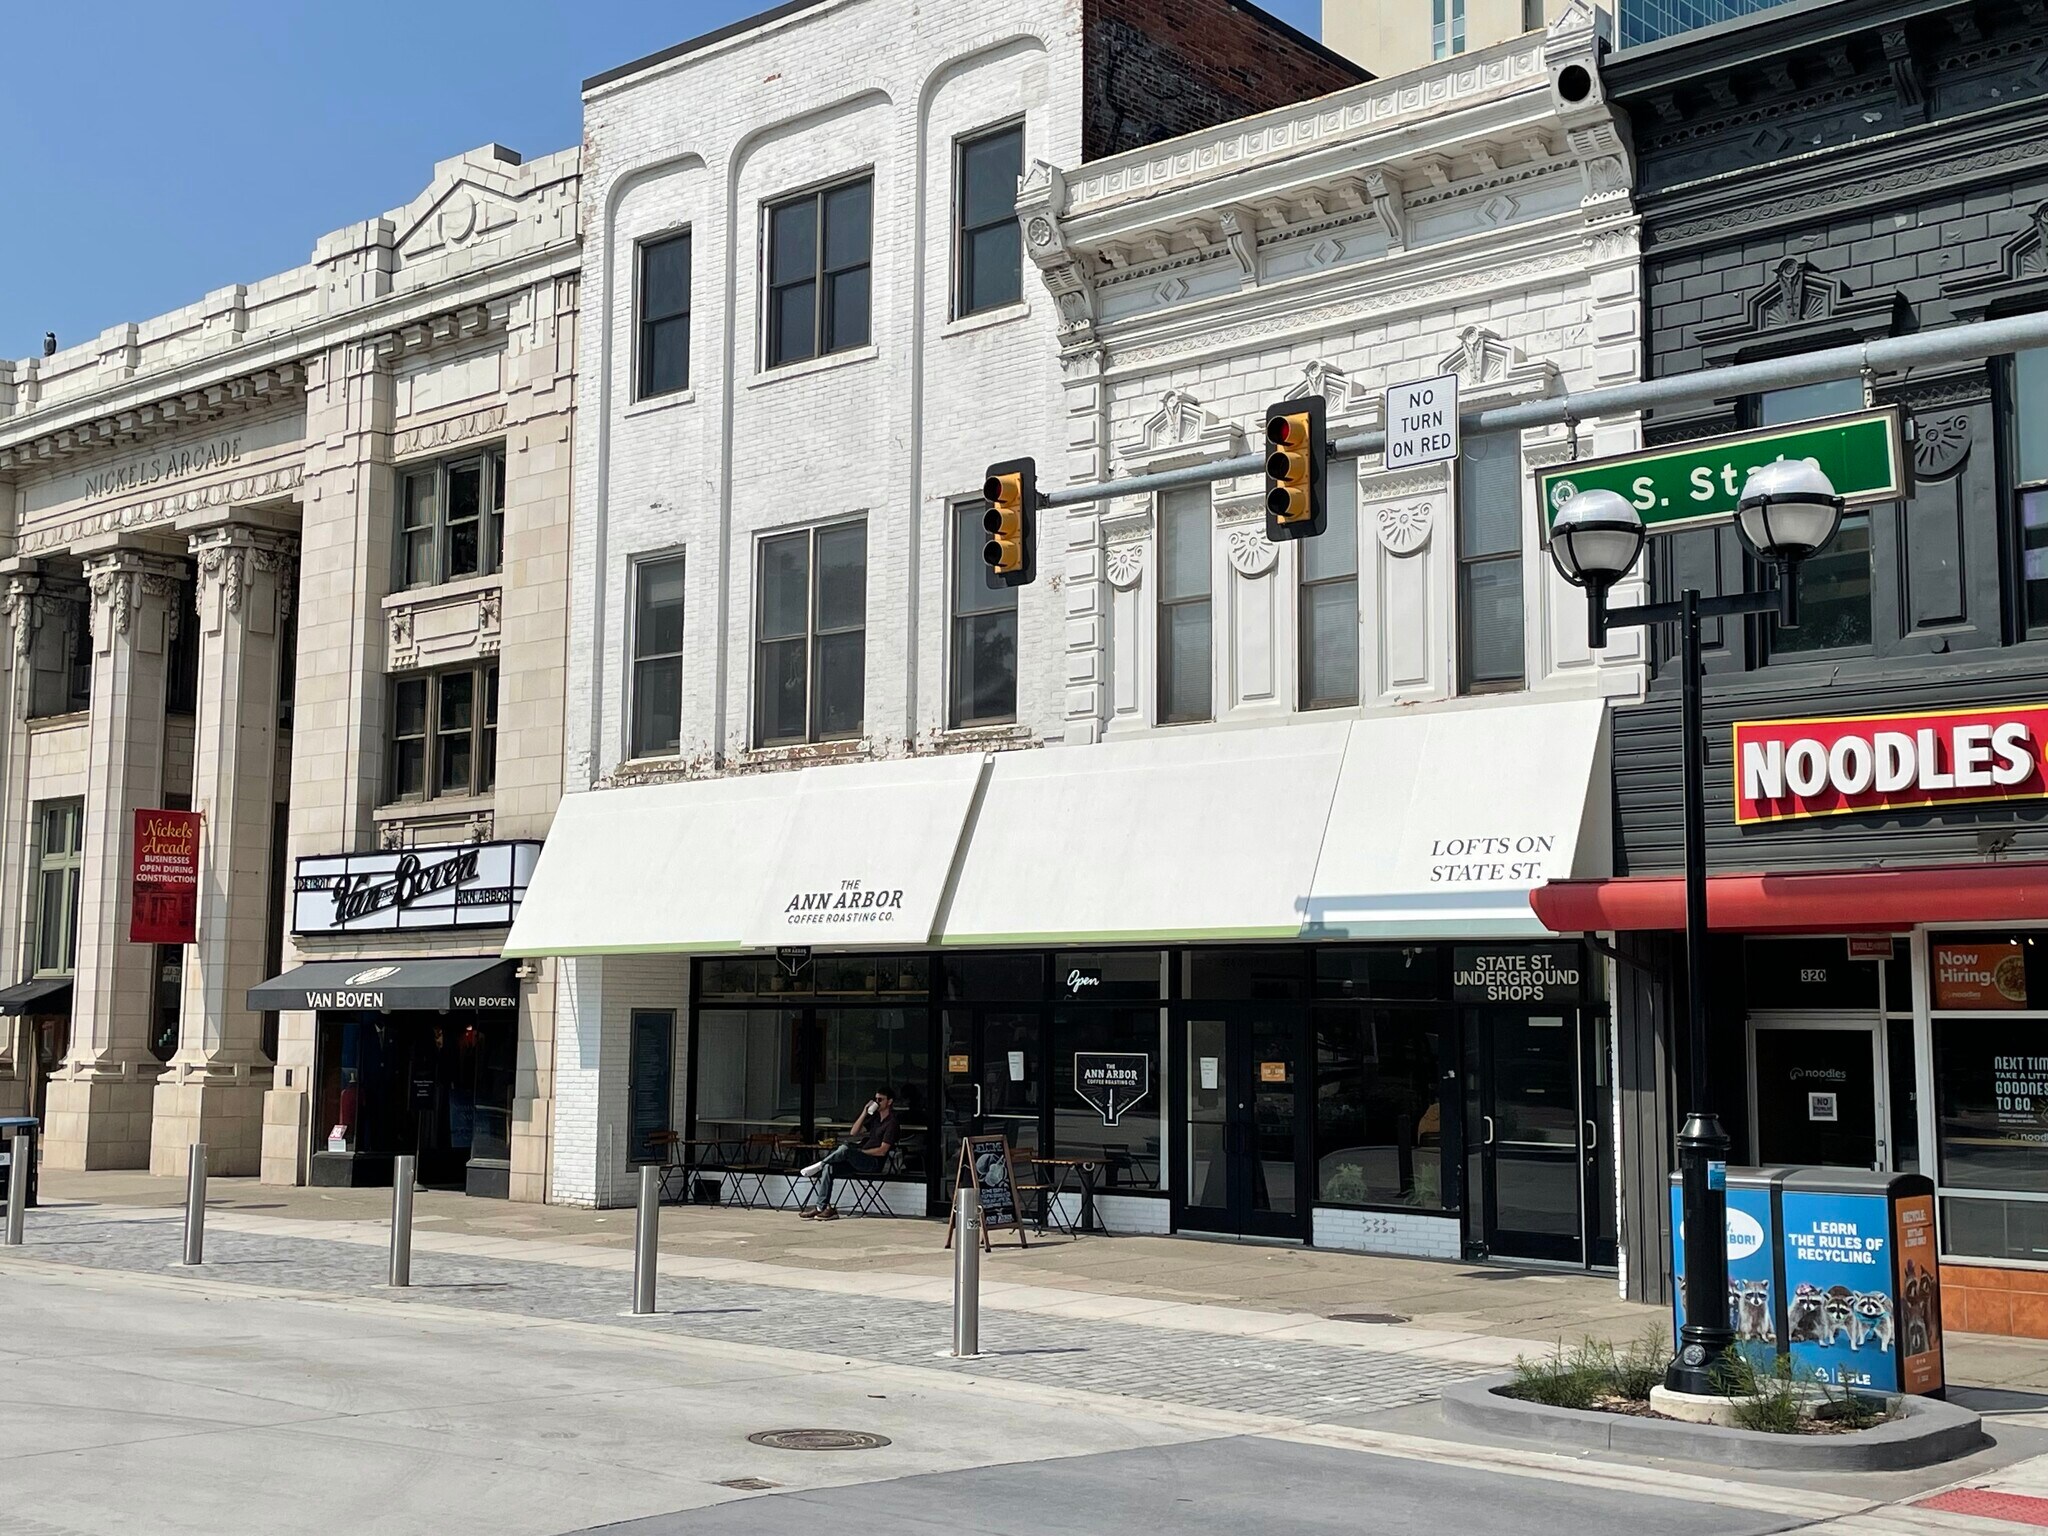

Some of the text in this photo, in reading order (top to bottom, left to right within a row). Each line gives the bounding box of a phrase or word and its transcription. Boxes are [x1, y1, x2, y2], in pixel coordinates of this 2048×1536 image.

[1410, 389, 1434, 409] NO
[1401, 410, 1442, 433] TURN
[1393, 433, 1451, 458] ON RED
[85, 437, 242, 500] NICKELS ARCADE
[1631, 476, 1670, 511] S.
[1743, 722, 2035, 800] NOODLES
[142, 818, 194, 839] Nickels
[141, 836, 192, 856] Arcade
[1430, 835, 1556, 857] LOFTS ON
[144, 855, 190, 865] BUSINESSES
[139, 864, 194, 874] OPEN DURING
[1430, 861, 1542, 883] STATE ST.
[136, 873, 197, 884] CONSTRUCTION
[840, 879, 861, 890] THE
[330, 849, 480, 927] Van Boven
[456, 888, 510, 905] ANN ARBOR
[784, 889, 904, 913] ANN ARBOR
[787, 911, 895, 924] COFFEE ROASTING CO.
[1476, 955, 1555, 971] STATE ST.
[1939, 951, 1978, 966] Now
[1066, 969, 1100, 994] Open
[1453, 970, 1580, 986] UNDERGROUND
[1801, 970, 1826, 982] 320
[1940, 968, 1995, 987] Hiring.
[306, 991, 383, 1008] VAN BOVEN
[454, 997, 516, 1007] VAN BOVEN
[1487, 986, 1544, 1001] SHOPS
[1994, 1056, 2024, 1070] NEXT
[1084, 1069, 1138, 1080] ANN ARBOR
[1805, 1068, 1847, 1079] noodles
[1817, 1098, 1829, 1106] NO
[1996, 1096, 2035, 1111] TO GO.
[1812, 1221, 1857, 1235] LEARN
[1788, 1233, 1884, 1251] THE RULES OF
[1797, 1248, 1876, 1265] RECYCLING.
